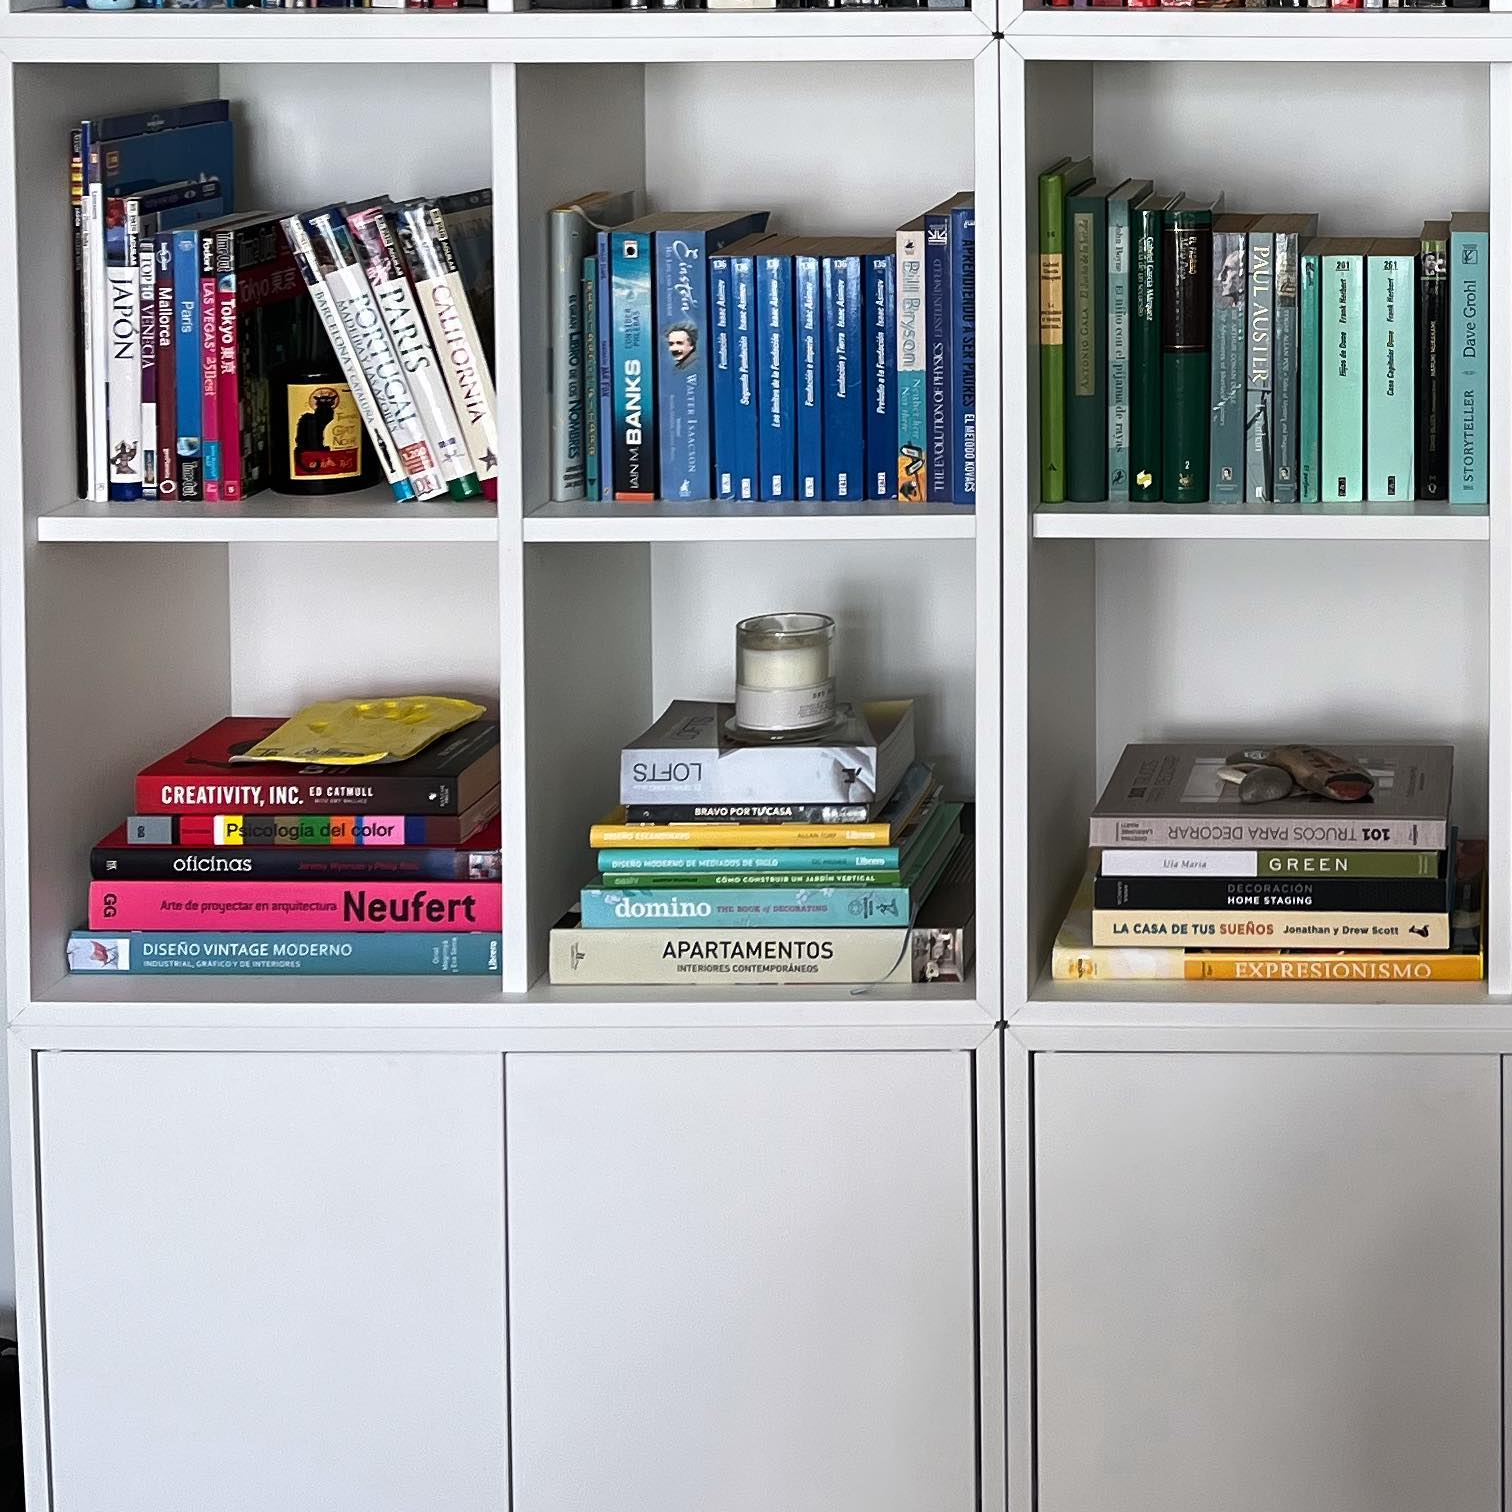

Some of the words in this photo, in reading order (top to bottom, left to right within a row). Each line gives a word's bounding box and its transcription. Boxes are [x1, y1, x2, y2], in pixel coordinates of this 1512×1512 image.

[901, 261, 920, 293] Bill
[1252, 245, 1271, 295] PAUL
[1461, 279, 1477, 319] Grohl
[109, 277, 139, 360] JAPÓN
[158, 286, 173, 346] Mallorca
[378, 287, 433, 374] PARÍS
[901, 298, 924, 365] Bryson
[1462, 321, 1476, 358] Dave
[431, 283, 488, 425] CALIFORNIA
[1250, 302, 1270, 383] AUSTER
[349, 292, 417, 431] PORTUGAL
[623, 359, 642, 445] BANKS
[1462, 388, 1475, 483] STORYTELLER
[628, 467, 639, 489] IAIN
[632, 762, 703, 783] LOFTS
[160, 785, 266, 808] CREATIVITY,
[269, 786, 305, 807] INC.
[308, 786, 322, 797] ED
[325, 786, 374, 797] CATMULL
[225, 821, 315, 841] Psicología
[319, 820, 346, 838] del
[351, 820, 395, 838] color
[1167, 825, 1244, 840] DECORAR
[1247, 825, 1290, 840] PARA
[1292, 826, 1358, 841] TRUCOS
[1361, 827, 1392, 842] 101
[172, 854, 252, 873] oficinas
[1268, 857, 1349, 873] GREEN
[1226, 882, 1314, 894] DECORACIÓN
[103, 893, 118, 919] GG
[342, 890, 477, 924] Neufert
[613, 897, 712, 918] domino
[716, 904, 735, 914] THE
[736, 904, 762, 914] BOOK
[1226, 895, 1261, 905] HOME
[1263, 895, 1313, 906] STAGING
[142, 937, 201, 957] DISEÑO
[203, 944, 269, 957] VINTAGE
[271, 944, 353, 957] MODERNO
[488, 940, 498, 971] Librero
[661, 940, 835, 960] APARTAMENTOS
[676, 963, 731, 973] INTERIORES
[731, 962, 819, 974] CONTEMPORÁNEOS
[1234, 961, 1433, 980] EXPRESIONISMO
